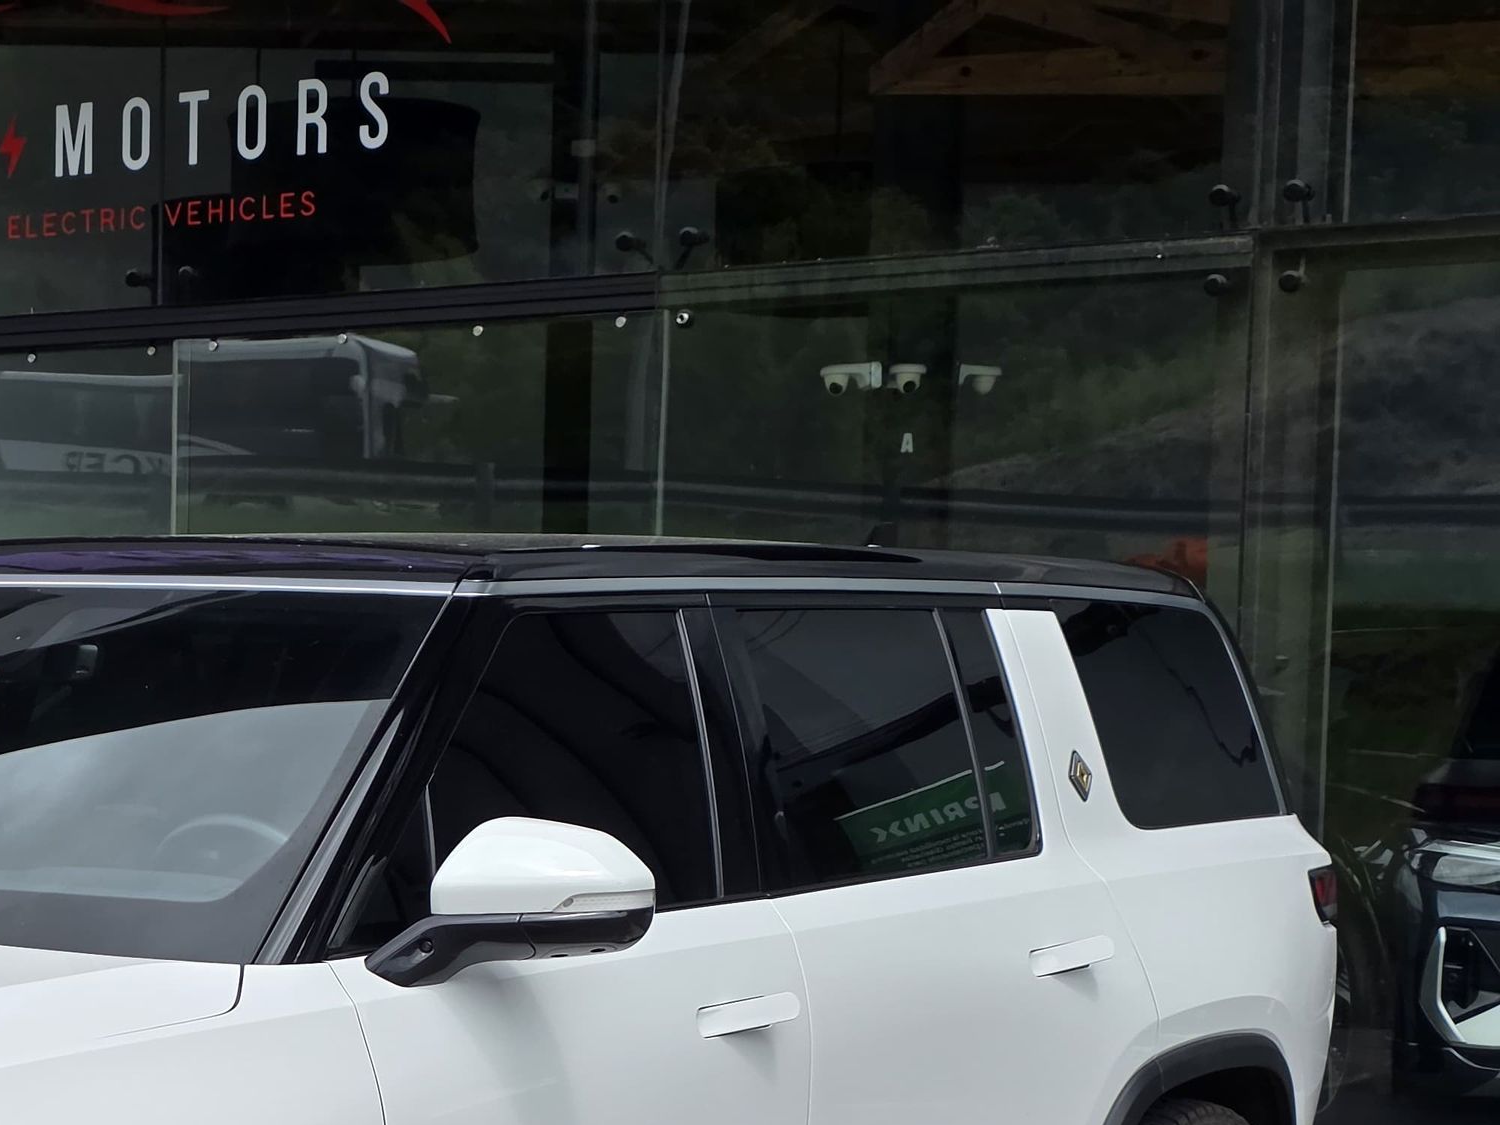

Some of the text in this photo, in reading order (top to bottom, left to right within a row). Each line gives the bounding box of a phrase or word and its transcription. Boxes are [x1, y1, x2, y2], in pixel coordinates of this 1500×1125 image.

[55, 71, 390, 178] MOTORS
[7, 191, 317, 240] ELECTRIC VEHICLES
